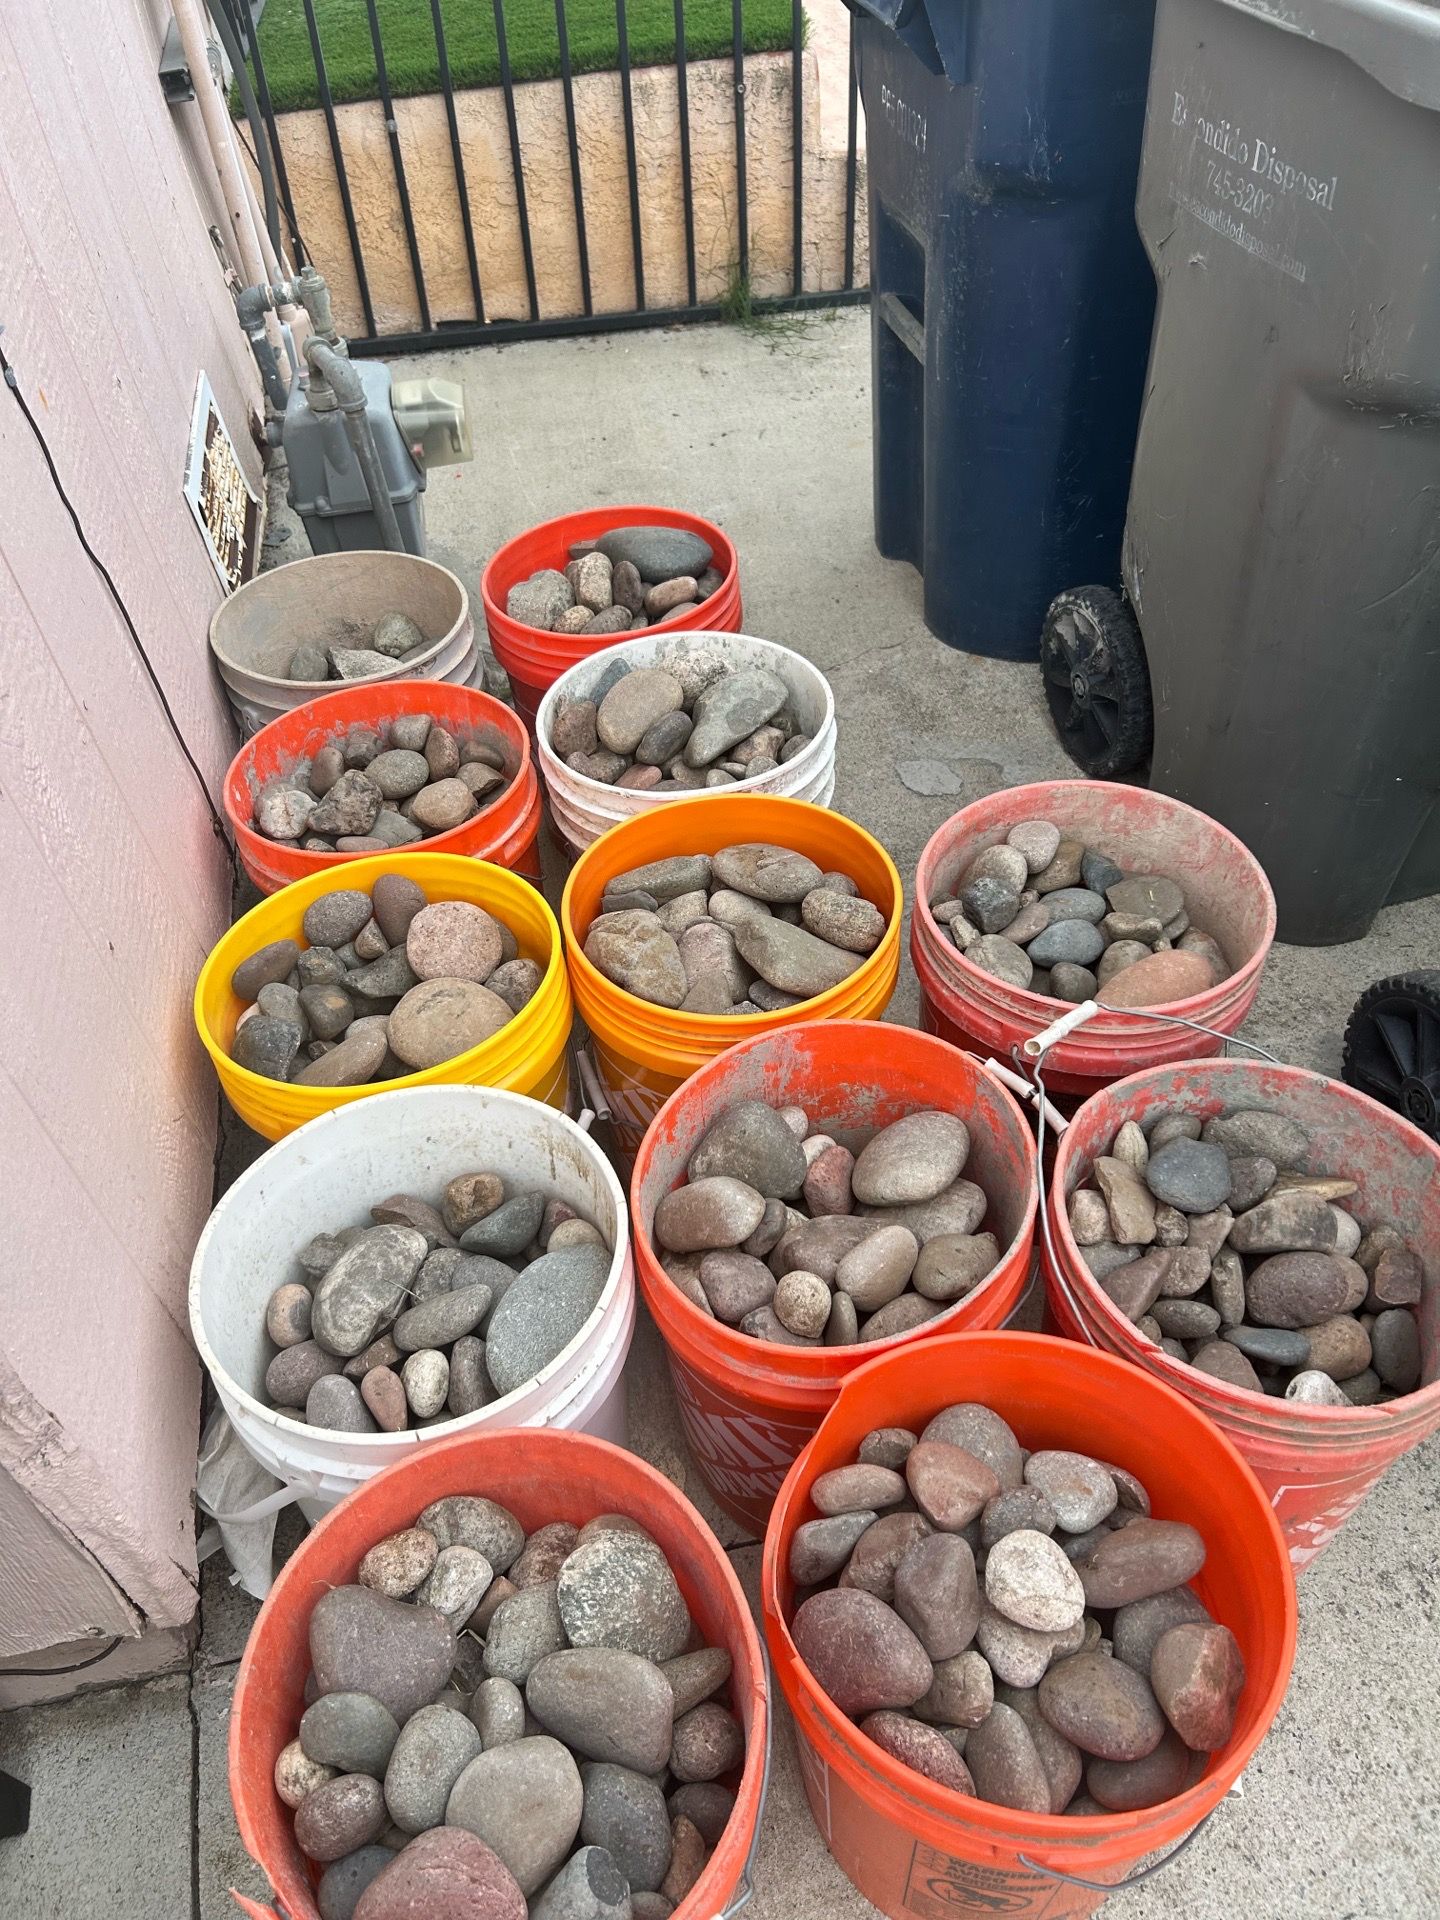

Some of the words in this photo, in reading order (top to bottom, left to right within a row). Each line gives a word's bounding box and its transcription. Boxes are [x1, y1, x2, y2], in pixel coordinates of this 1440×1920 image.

[1251, 138, 1338, 211] Disposal
[946, 1864, 1007, 1884] AVISO
[949, 1856, 1045, 1880] WARNING
